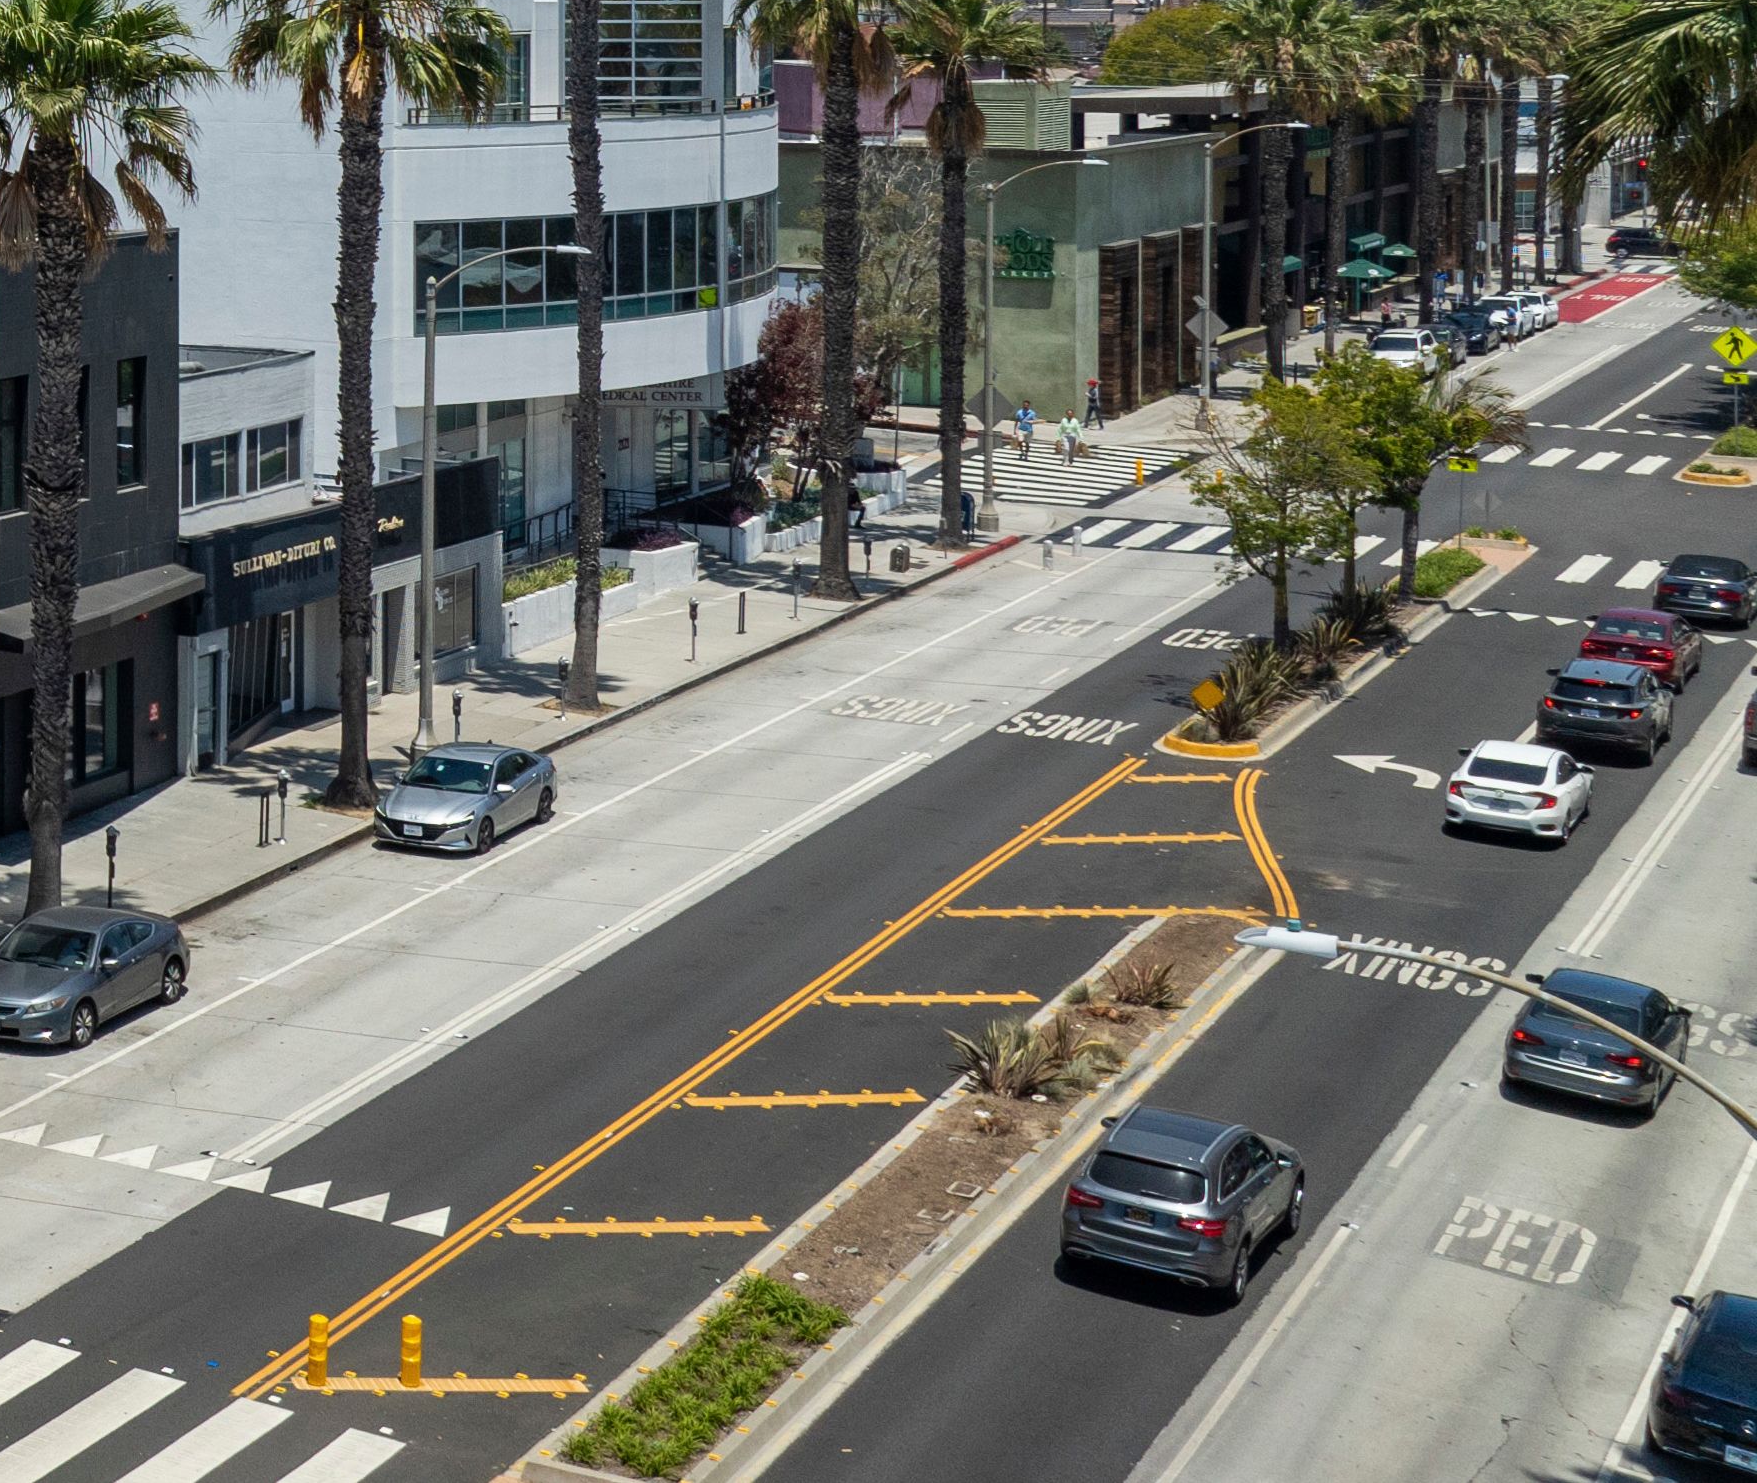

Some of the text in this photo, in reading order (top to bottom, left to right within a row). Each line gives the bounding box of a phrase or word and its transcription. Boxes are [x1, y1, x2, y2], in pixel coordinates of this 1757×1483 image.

[601, 390, 703, 403] EDICAL CENTER
[1012, 616, 1106, 637] PED
[831, 695, 972, 726] XINGS
[996, 711, 1139, 745] XINGS
[1321, 933, 1507, 997] XINGS
[1433, 1196, 1597, 1284] PED
